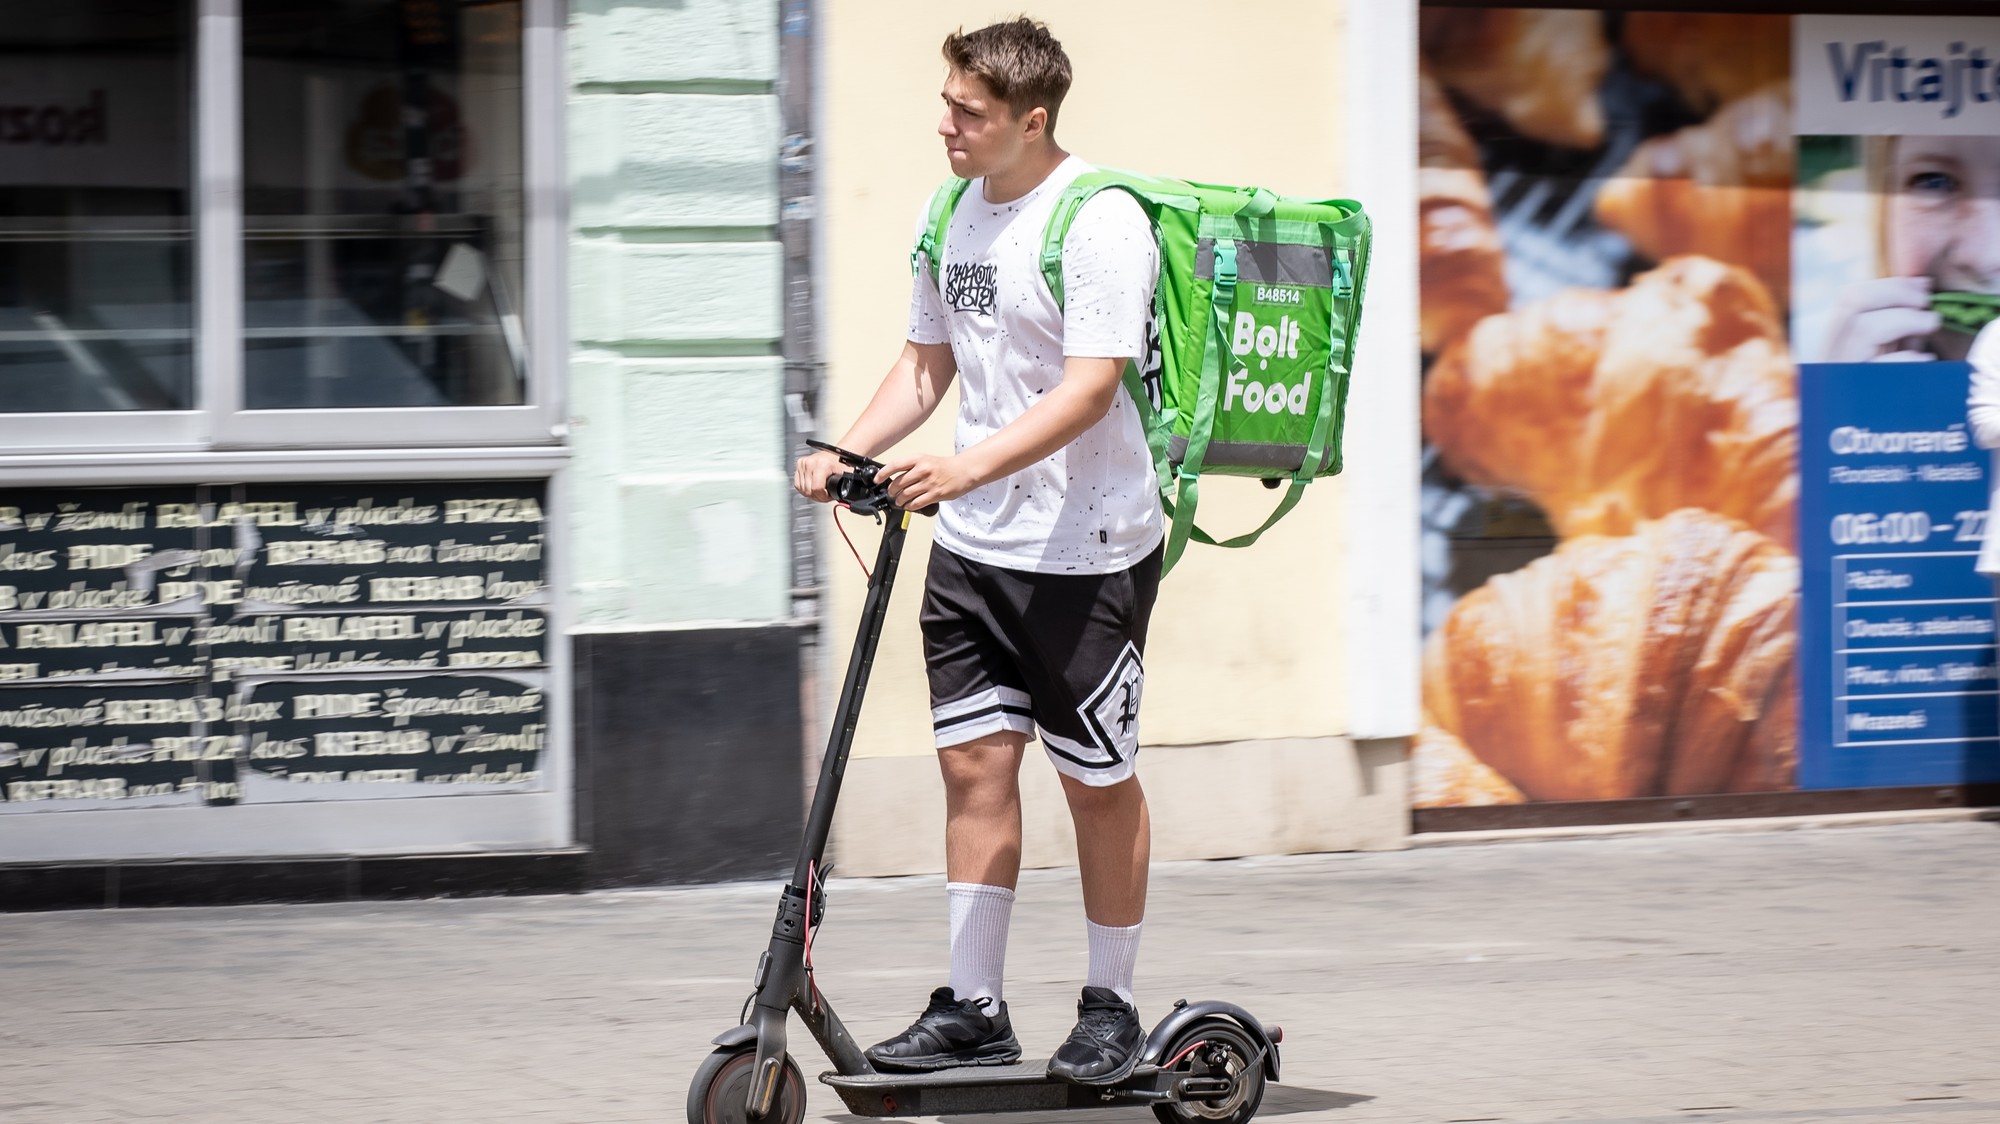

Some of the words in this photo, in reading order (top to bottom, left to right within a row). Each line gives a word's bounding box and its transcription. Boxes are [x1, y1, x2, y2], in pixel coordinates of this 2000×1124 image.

[1256, 286, 1300, 304] B48514
[1232, 311, 1301, 359] Bolt
[1222, 367, 1312, 415] Food
[443, 498, 544, 524] PIZZA
[1830, 511, 1931, 545] 06:00
[368, 575, 485, 602] KEBAB
[283, 615, 423, 642] FALAFEL
[313, 730, 431, 757] KEBAB
